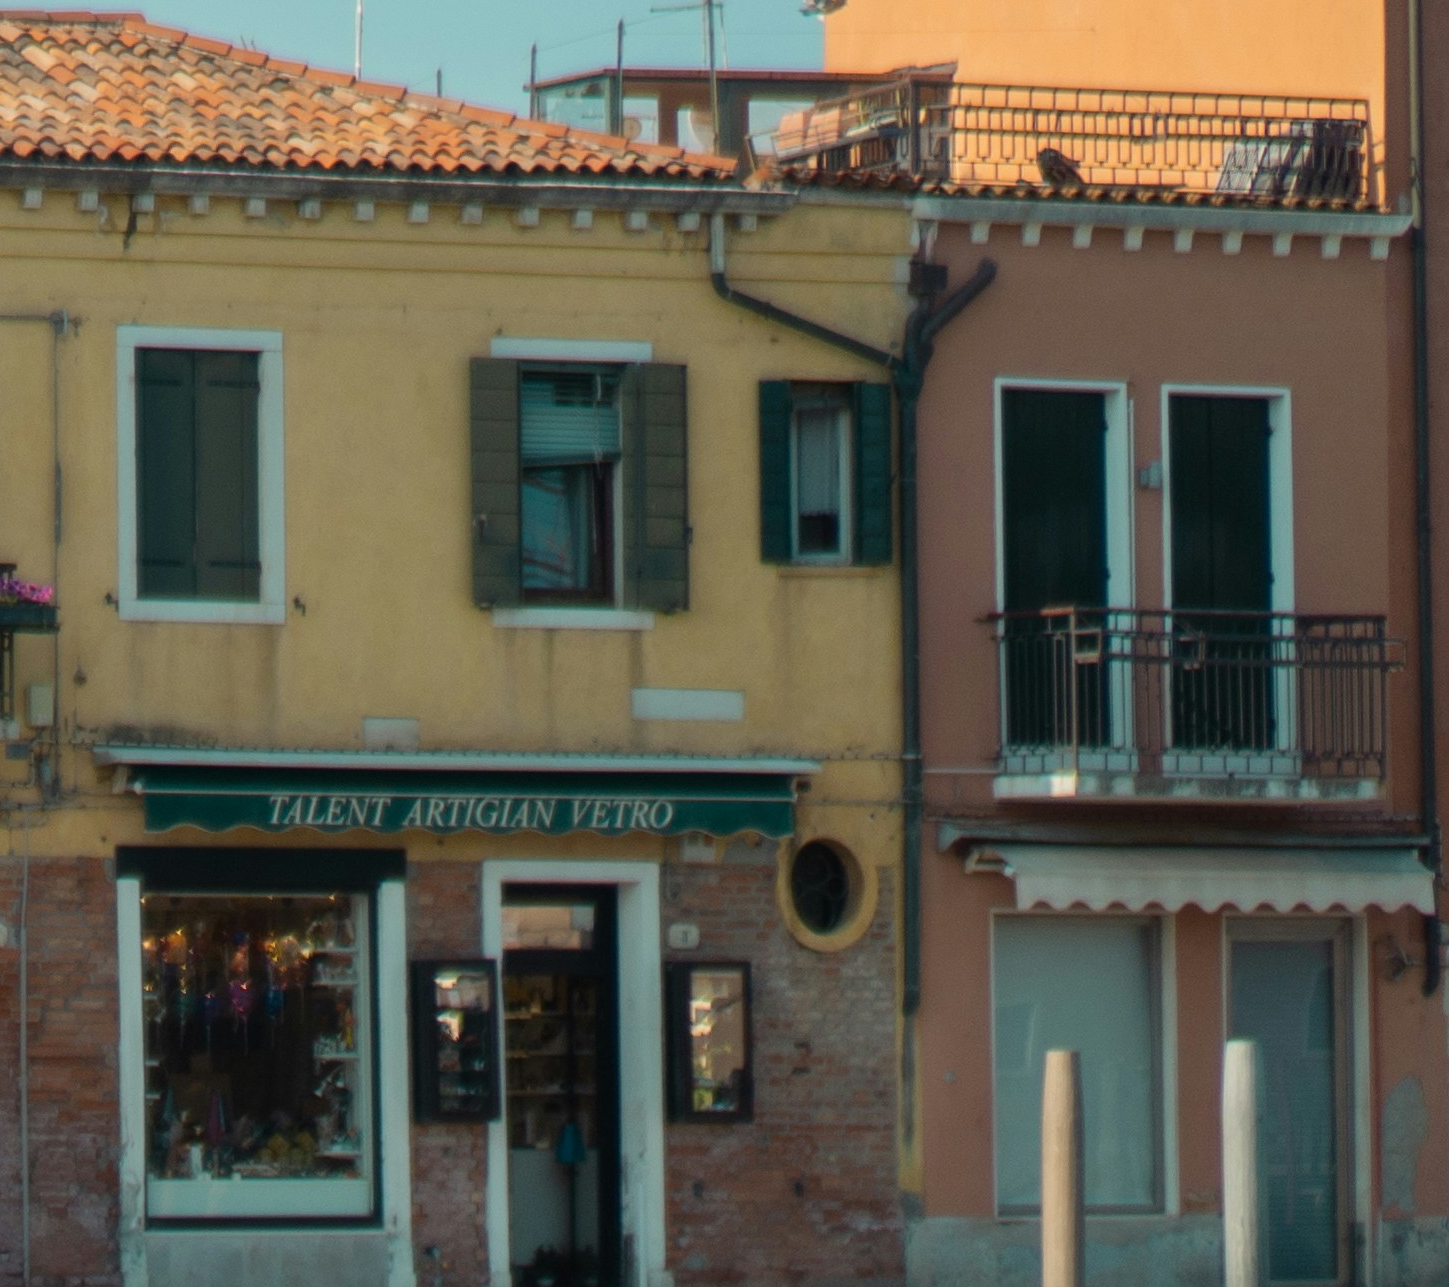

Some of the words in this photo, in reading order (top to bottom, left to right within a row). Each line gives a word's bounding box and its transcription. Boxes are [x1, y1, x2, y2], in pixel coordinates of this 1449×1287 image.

[269, 795, 392, 826] TALENT
[402, 798, 557, 829] ARTIGIAN
[570, 799, 674, 830] VETRO
